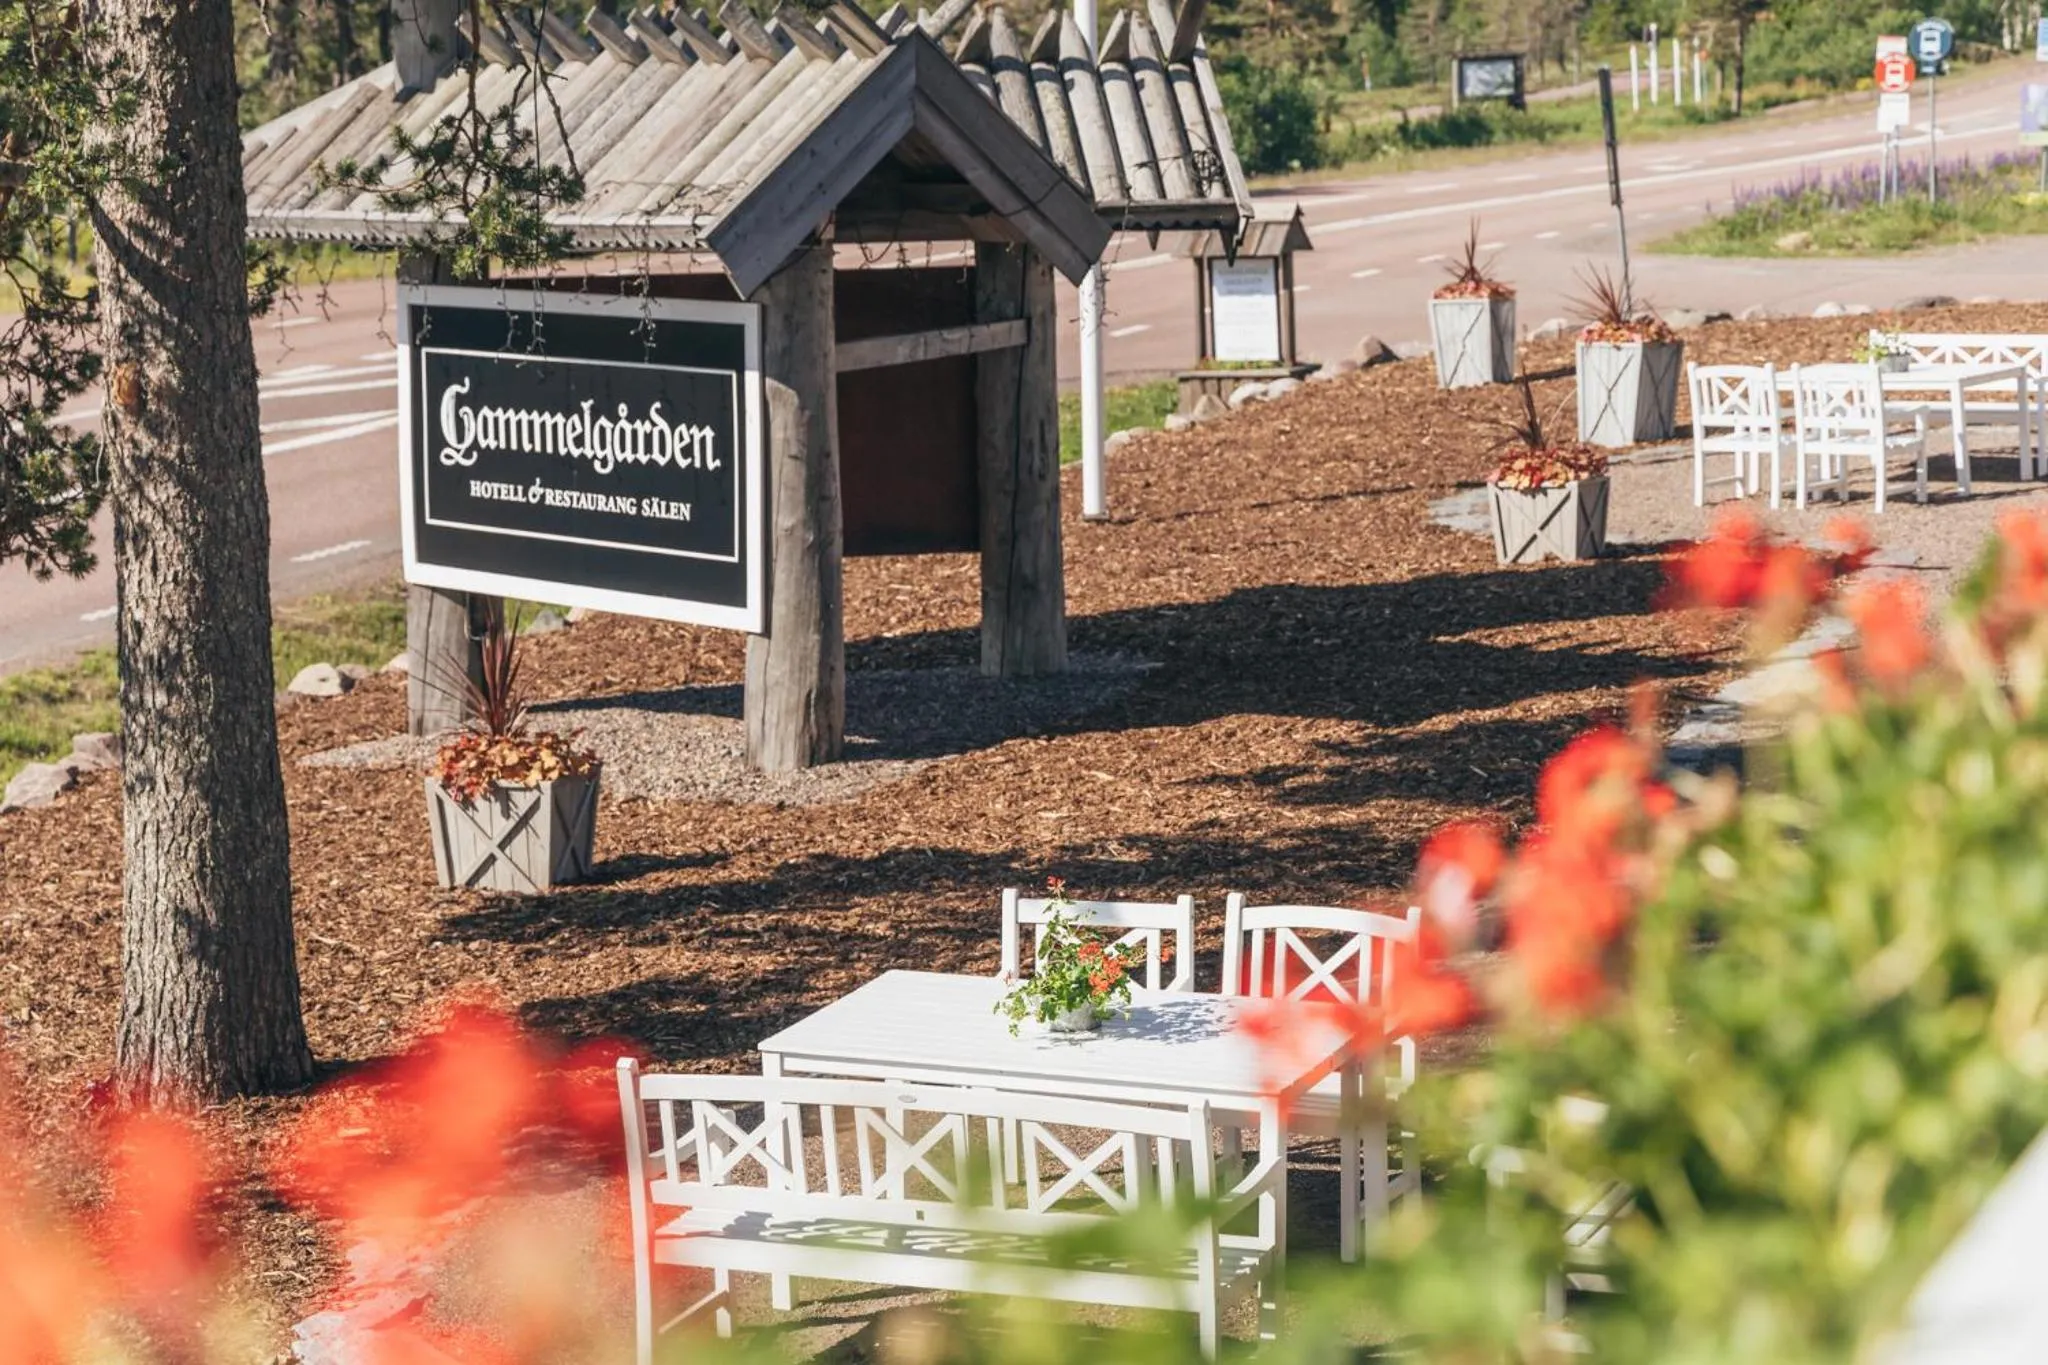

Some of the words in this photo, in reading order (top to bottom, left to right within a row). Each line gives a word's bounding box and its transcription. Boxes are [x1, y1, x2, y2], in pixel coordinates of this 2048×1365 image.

[439, 376, 721, 474] Gammelgården
[470, 480, 526, 503] HOTELL
[528, 477, 544, 504] &
[545, 488, 637, 515] RESTAURANG
[641, 497, 691, 521] SÄLEN
